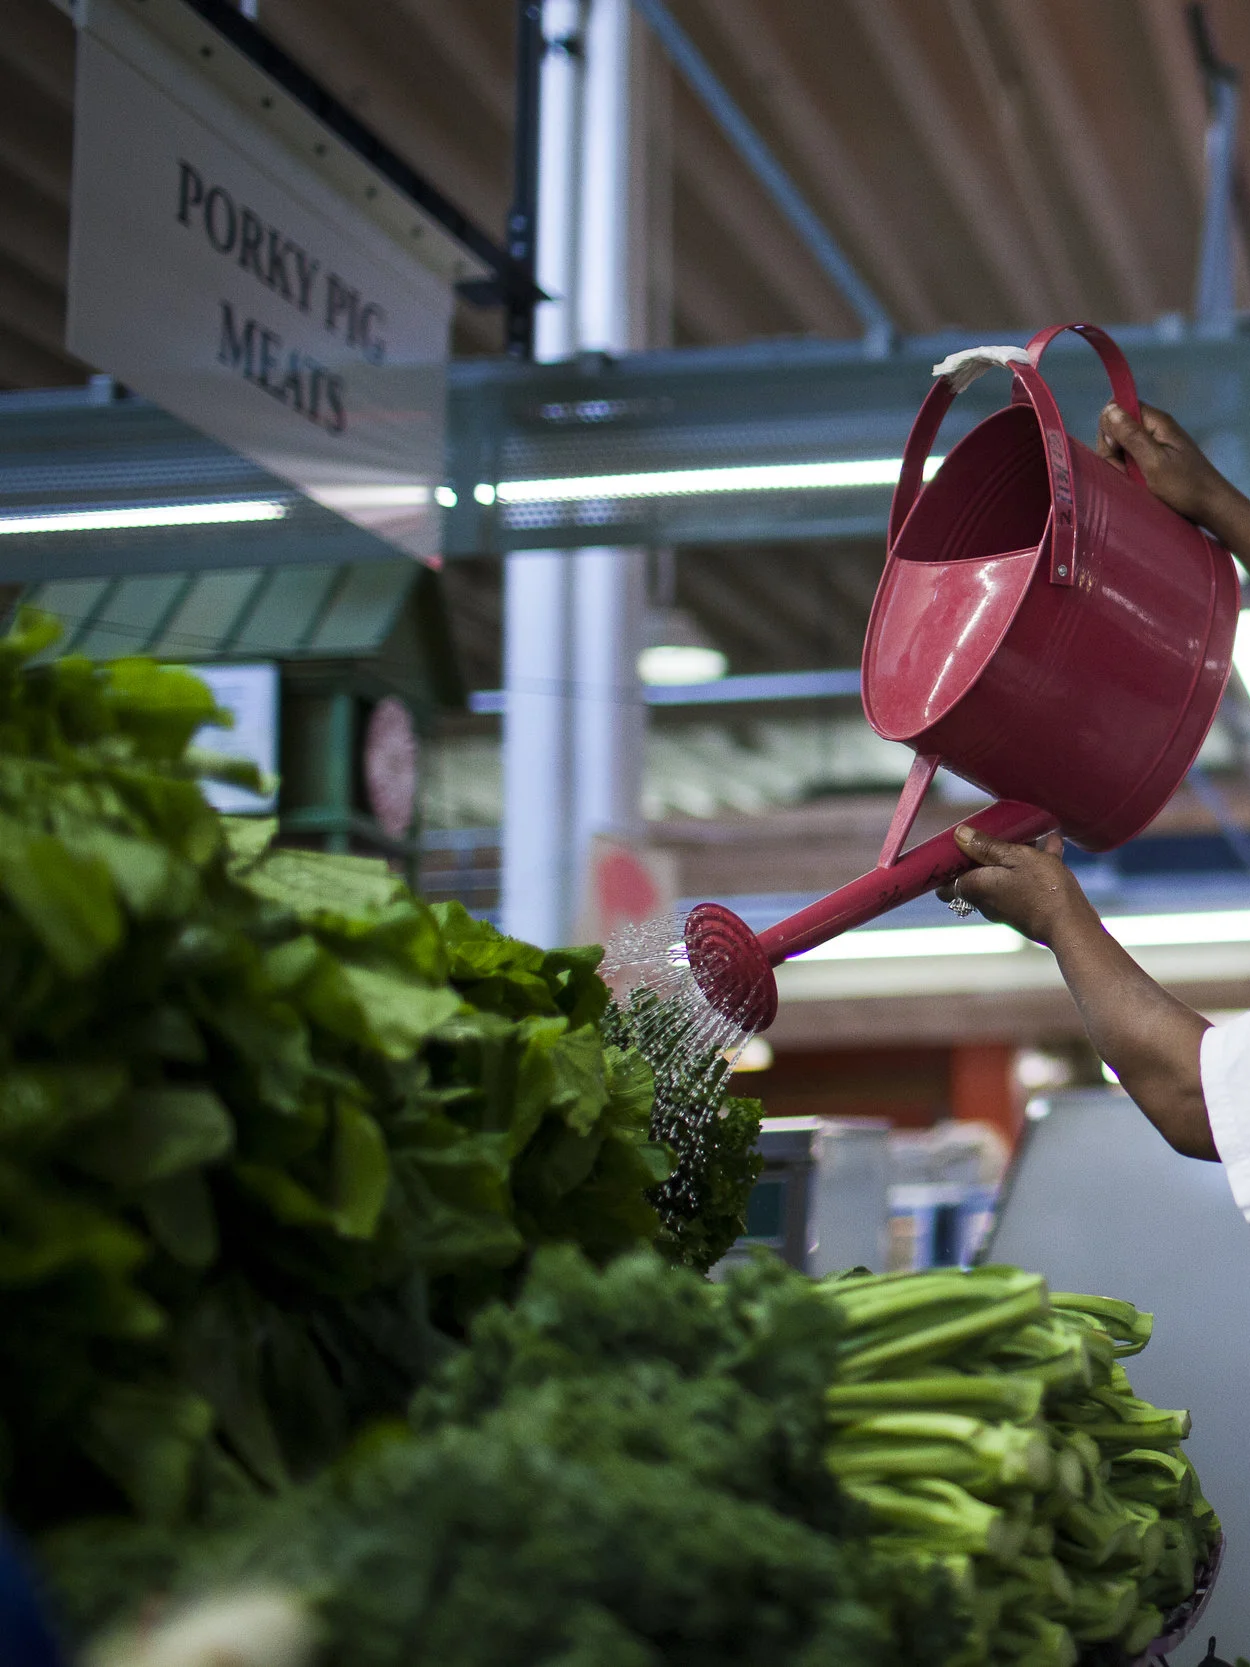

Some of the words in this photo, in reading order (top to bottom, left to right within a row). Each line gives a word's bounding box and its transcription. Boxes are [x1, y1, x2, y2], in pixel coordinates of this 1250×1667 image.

[177, 157, 320, 317] PORKY
[325, 271, 386, 367] PIG
[217, 299, 349, 438] MEATS
